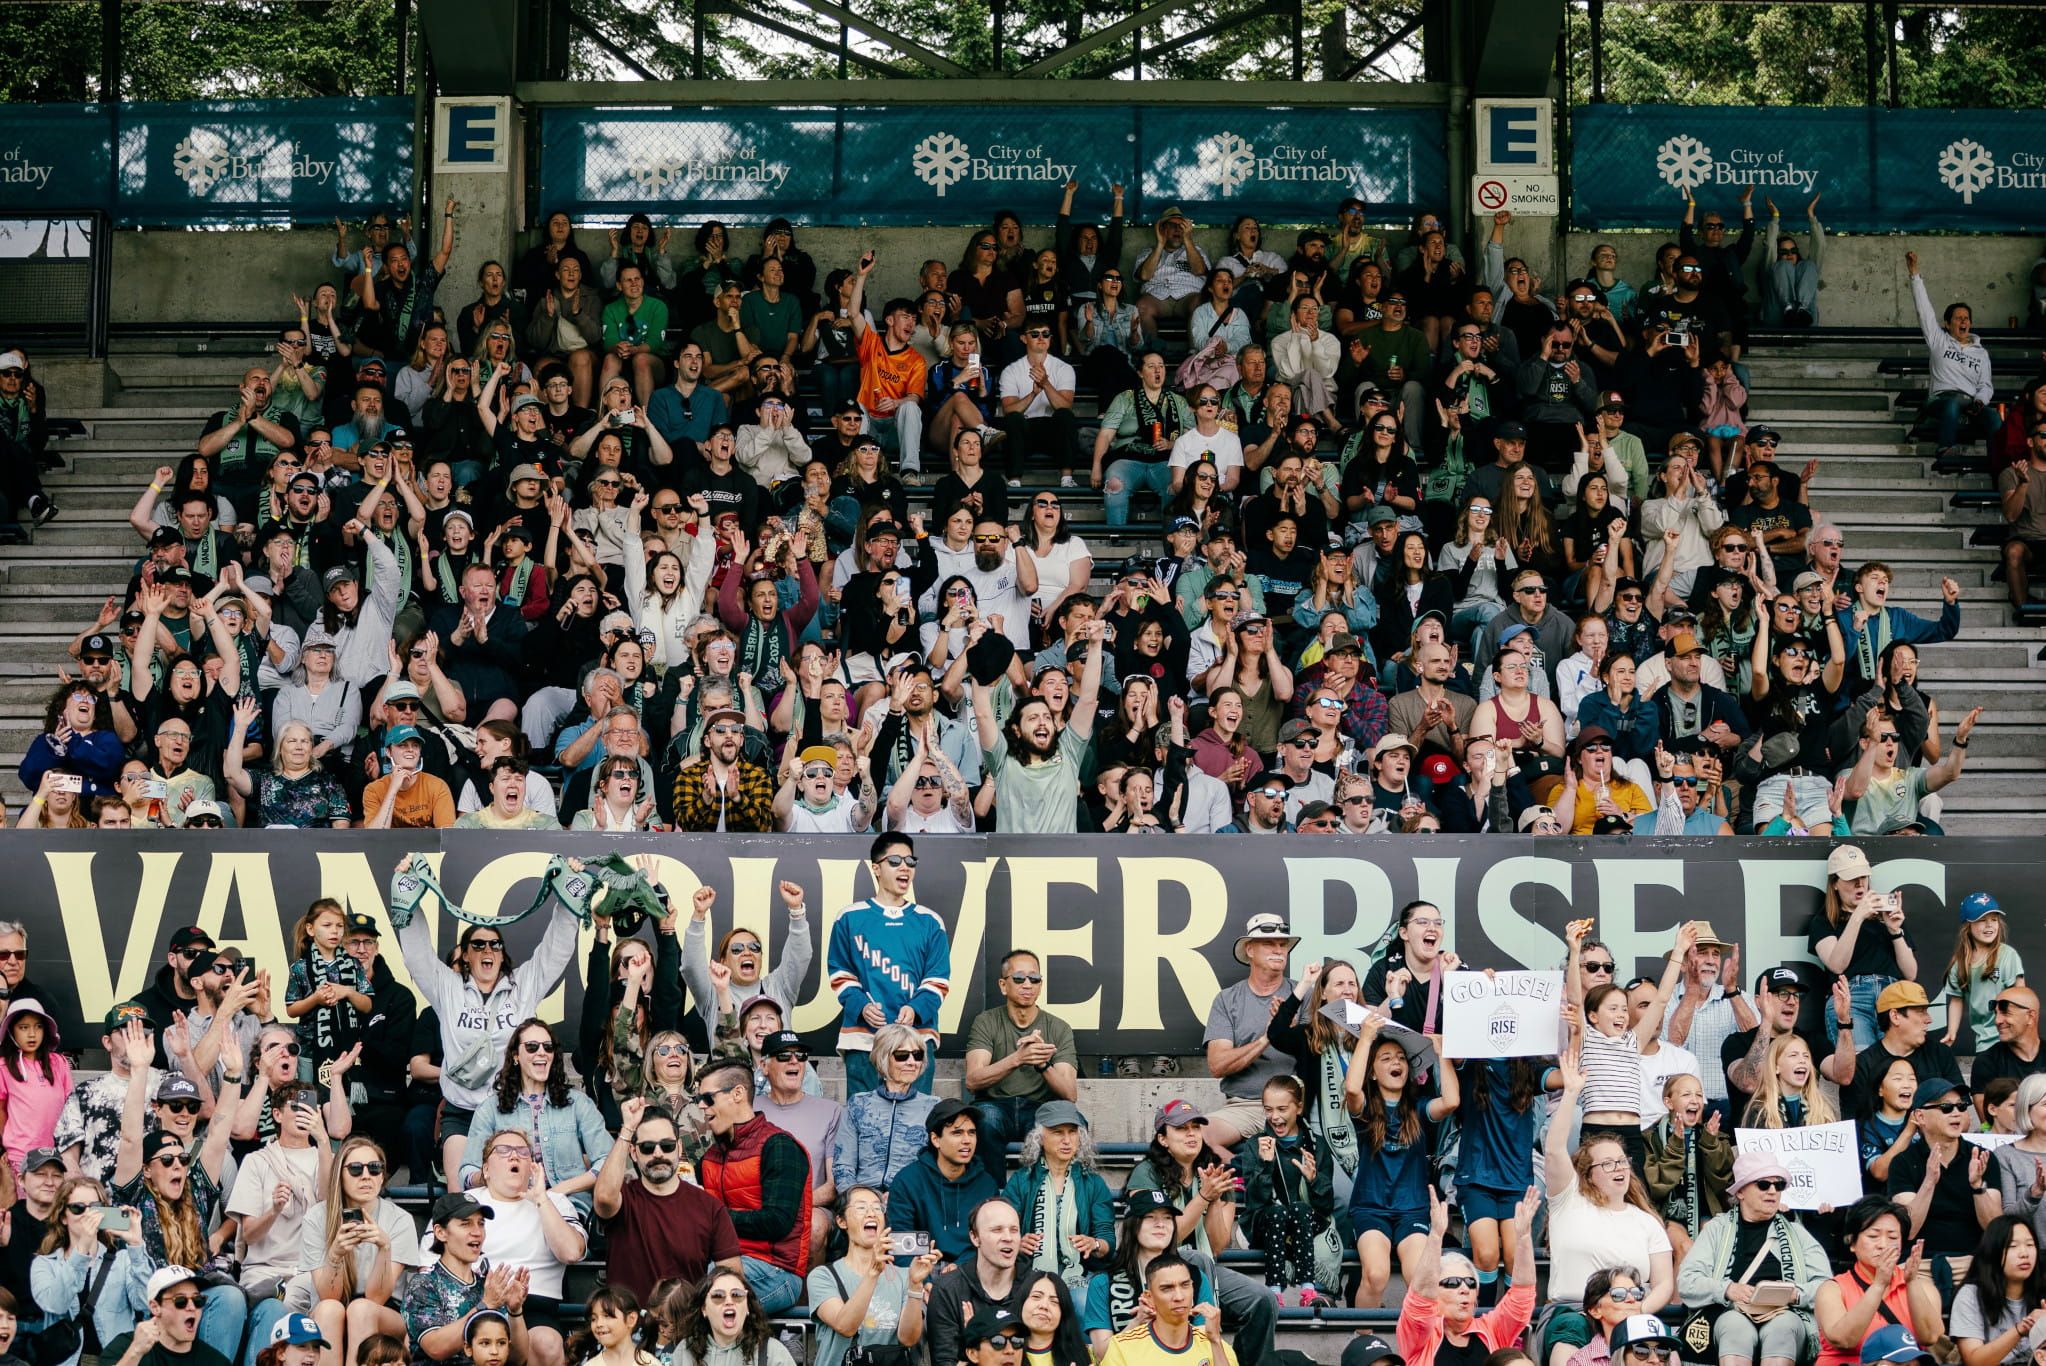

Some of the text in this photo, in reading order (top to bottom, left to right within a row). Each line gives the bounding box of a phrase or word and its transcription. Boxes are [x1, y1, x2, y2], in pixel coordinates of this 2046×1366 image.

[449, 106, 496, 162] E
[1491, 107, 1536, 163] E
[4, 145, 20, 161] of
[740, 145, 757, 160] of
[988, 144, 1042, 164] City of
[1273, 145, 1327, 163] City of
[1730, 148, 1783, 165] City of
[2012, 151, 2044, 171] City
[686, 158, 791, 190] Burnaby
[971, 157, 1077, 188] Burnaby
[1256, 158, 1361, 189] Burnaby
[1716, 161, 1819, 194] Burnaby
[1511, 194, 1556, 204] SMOKING
[1525, 184, 1540, 193] NO
[674, 613, 686, 640] EST.
[769, 635, 779, 664] 2026
[1283, 855, 1686, 1031] RISE
[1450, 974, 1554, 1004] GO RISE!
[496, 1013, 518, 1031] FC
[1490, 1020, 1517, 1036] RISE
[1742, 1129, 1849, 1155] GO RISE!
